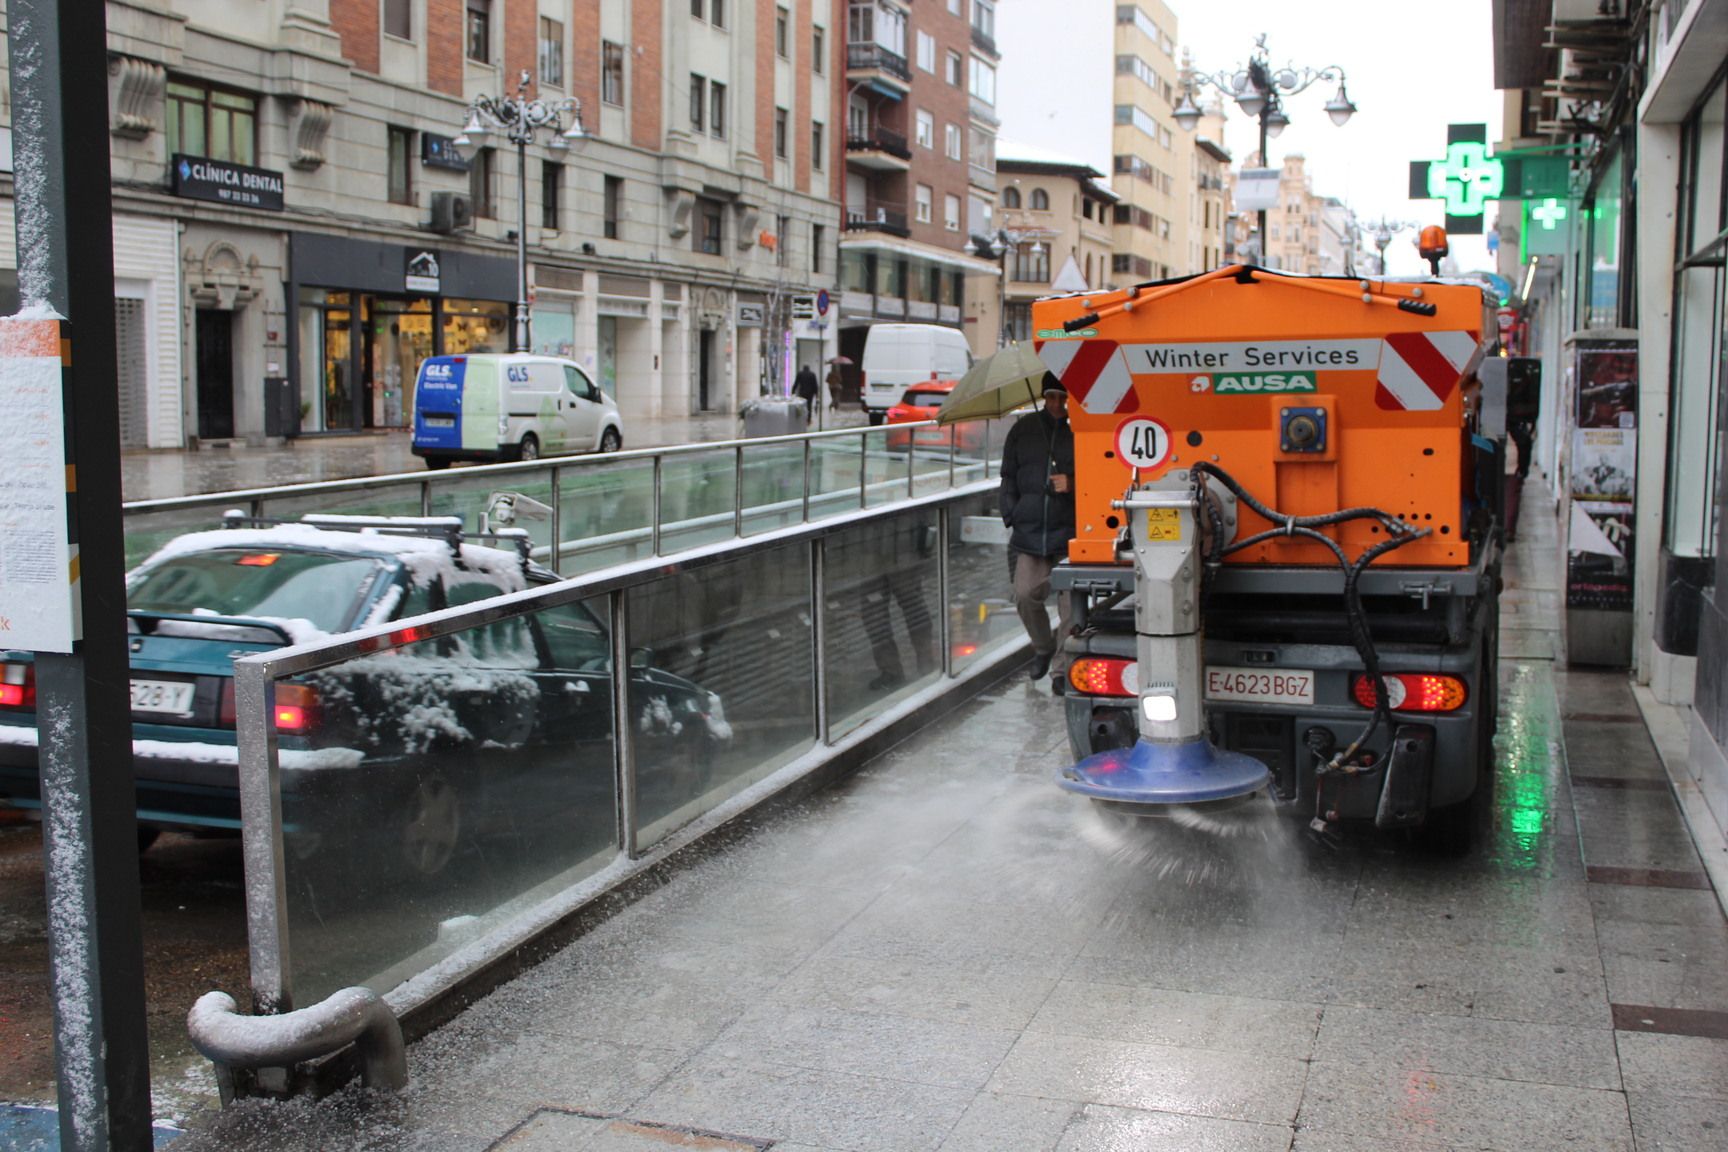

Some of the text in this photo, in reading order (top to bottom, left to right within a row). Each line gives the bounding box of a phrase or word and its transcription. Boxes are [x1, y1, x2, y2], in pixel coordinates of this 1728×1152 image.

[192, 162, 283, 194] CLÍNICA DENTAL
[1145, 345, 1359, 368] Winter Services
[1215, 374, 1315, 392] AUSA
[1131, 426, 1156, 460] 40
